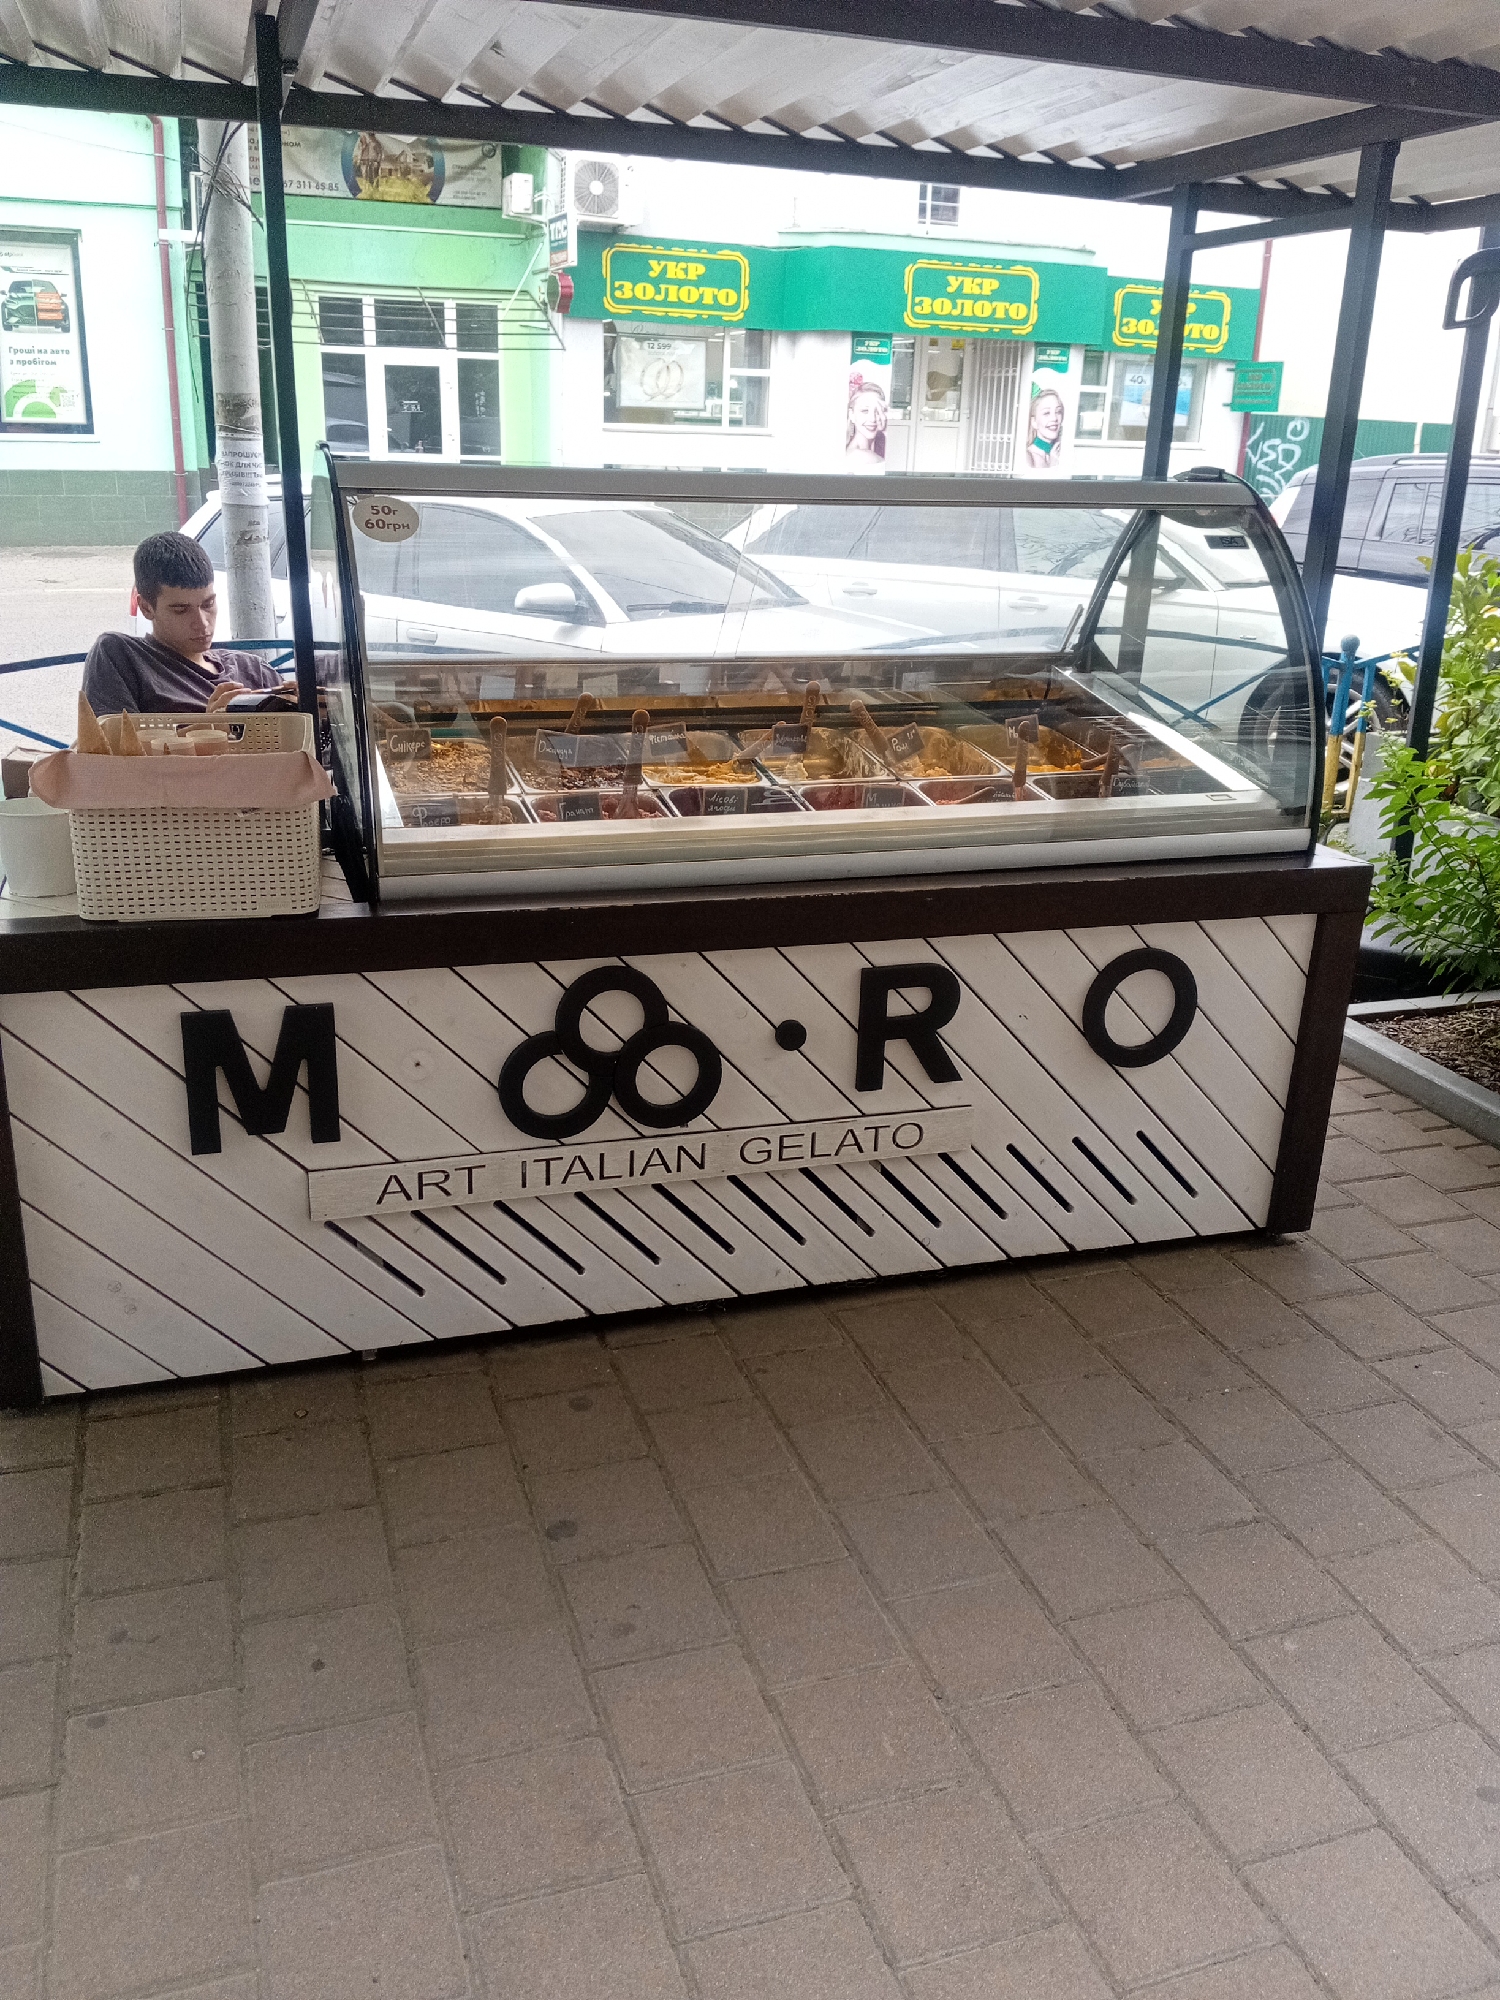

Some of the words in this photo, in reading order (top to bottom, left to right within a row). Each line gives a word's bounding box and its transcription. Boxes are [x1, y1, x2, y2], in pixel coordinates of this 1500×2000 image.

[296, 181, 311, 189] 311
[329, 182, 339, 191] 85
[648, 259, 706, 280] УКР
[614, 281, 738, 306] ЗОЛОТО
[946, 275, 1000, 296] УКР
[914, 296, 1028, 320] ЗОЛОТО
[9, 346, 35, 355] Гроші
[16, 358, 57, 366] пробігом
[370, 505, 398, 516] 50г
[364, 518, 410, 532] 60грн
[389, 734, 426, 753] Снікерс
[709, 792, 739, 804] Лісові
[559, 802, 594, 820] Гранат
[708, 804, 736, 814] ягоди
[375, 1163, 488, 1206] ART
[520, 1142, 708, 1190] ITALIAN
[738, 1120, 926, 1167] GELATO
